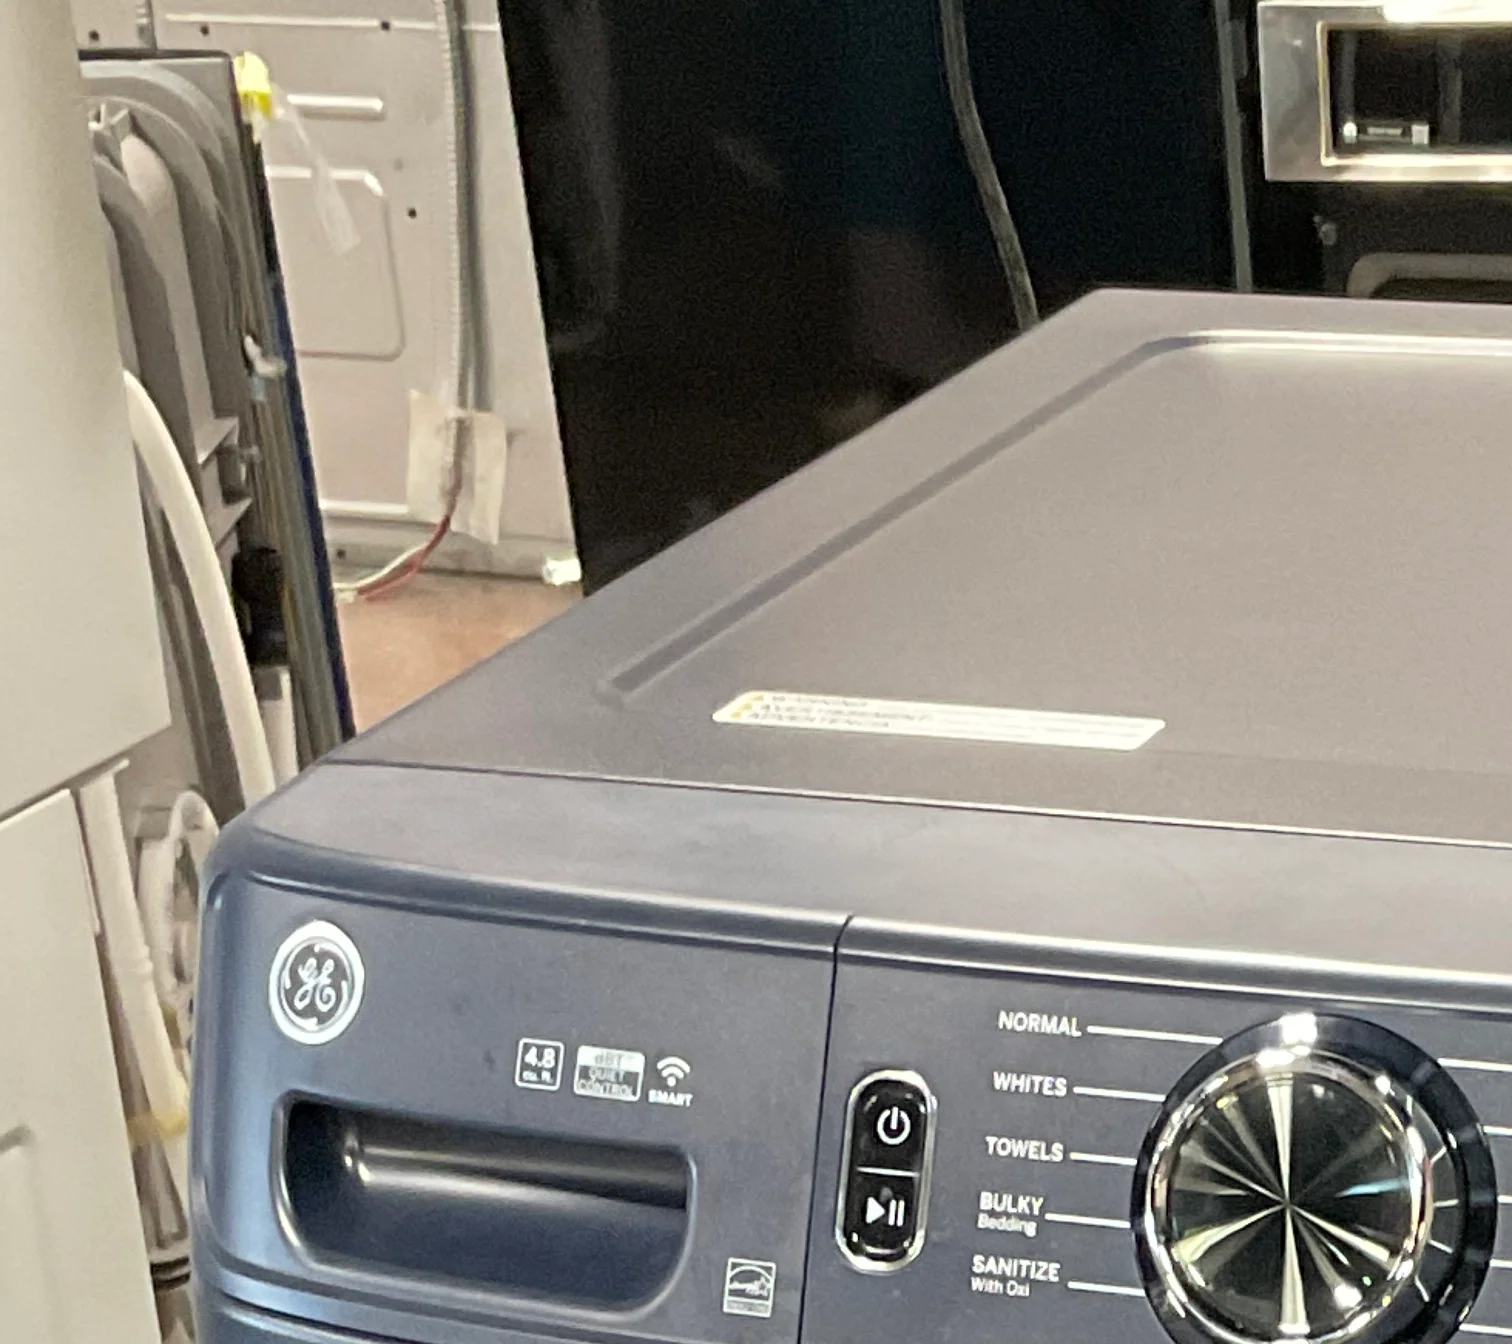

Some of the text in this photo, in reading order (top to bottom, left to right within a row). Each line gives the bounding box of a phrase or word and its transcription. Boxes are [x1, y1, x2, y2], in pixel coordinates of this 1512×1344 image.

[998, 1011, 1082, 1037] NORMAL
[523, 1045, 556, 1069] 4.8
[992, 1071, 1067, 1097] WHITES
[648, 1088, 694, 1107] SMART
[985, 1136, 1065, 1163] TOWELS
[978, 1191, 1045, 1217] BULKY
[976, 1214, 1038, 1238] Bedding
[971, 1255, 1061, 1283] SANITIZE
[970, 1276, 1030, 1297] With Oxi
